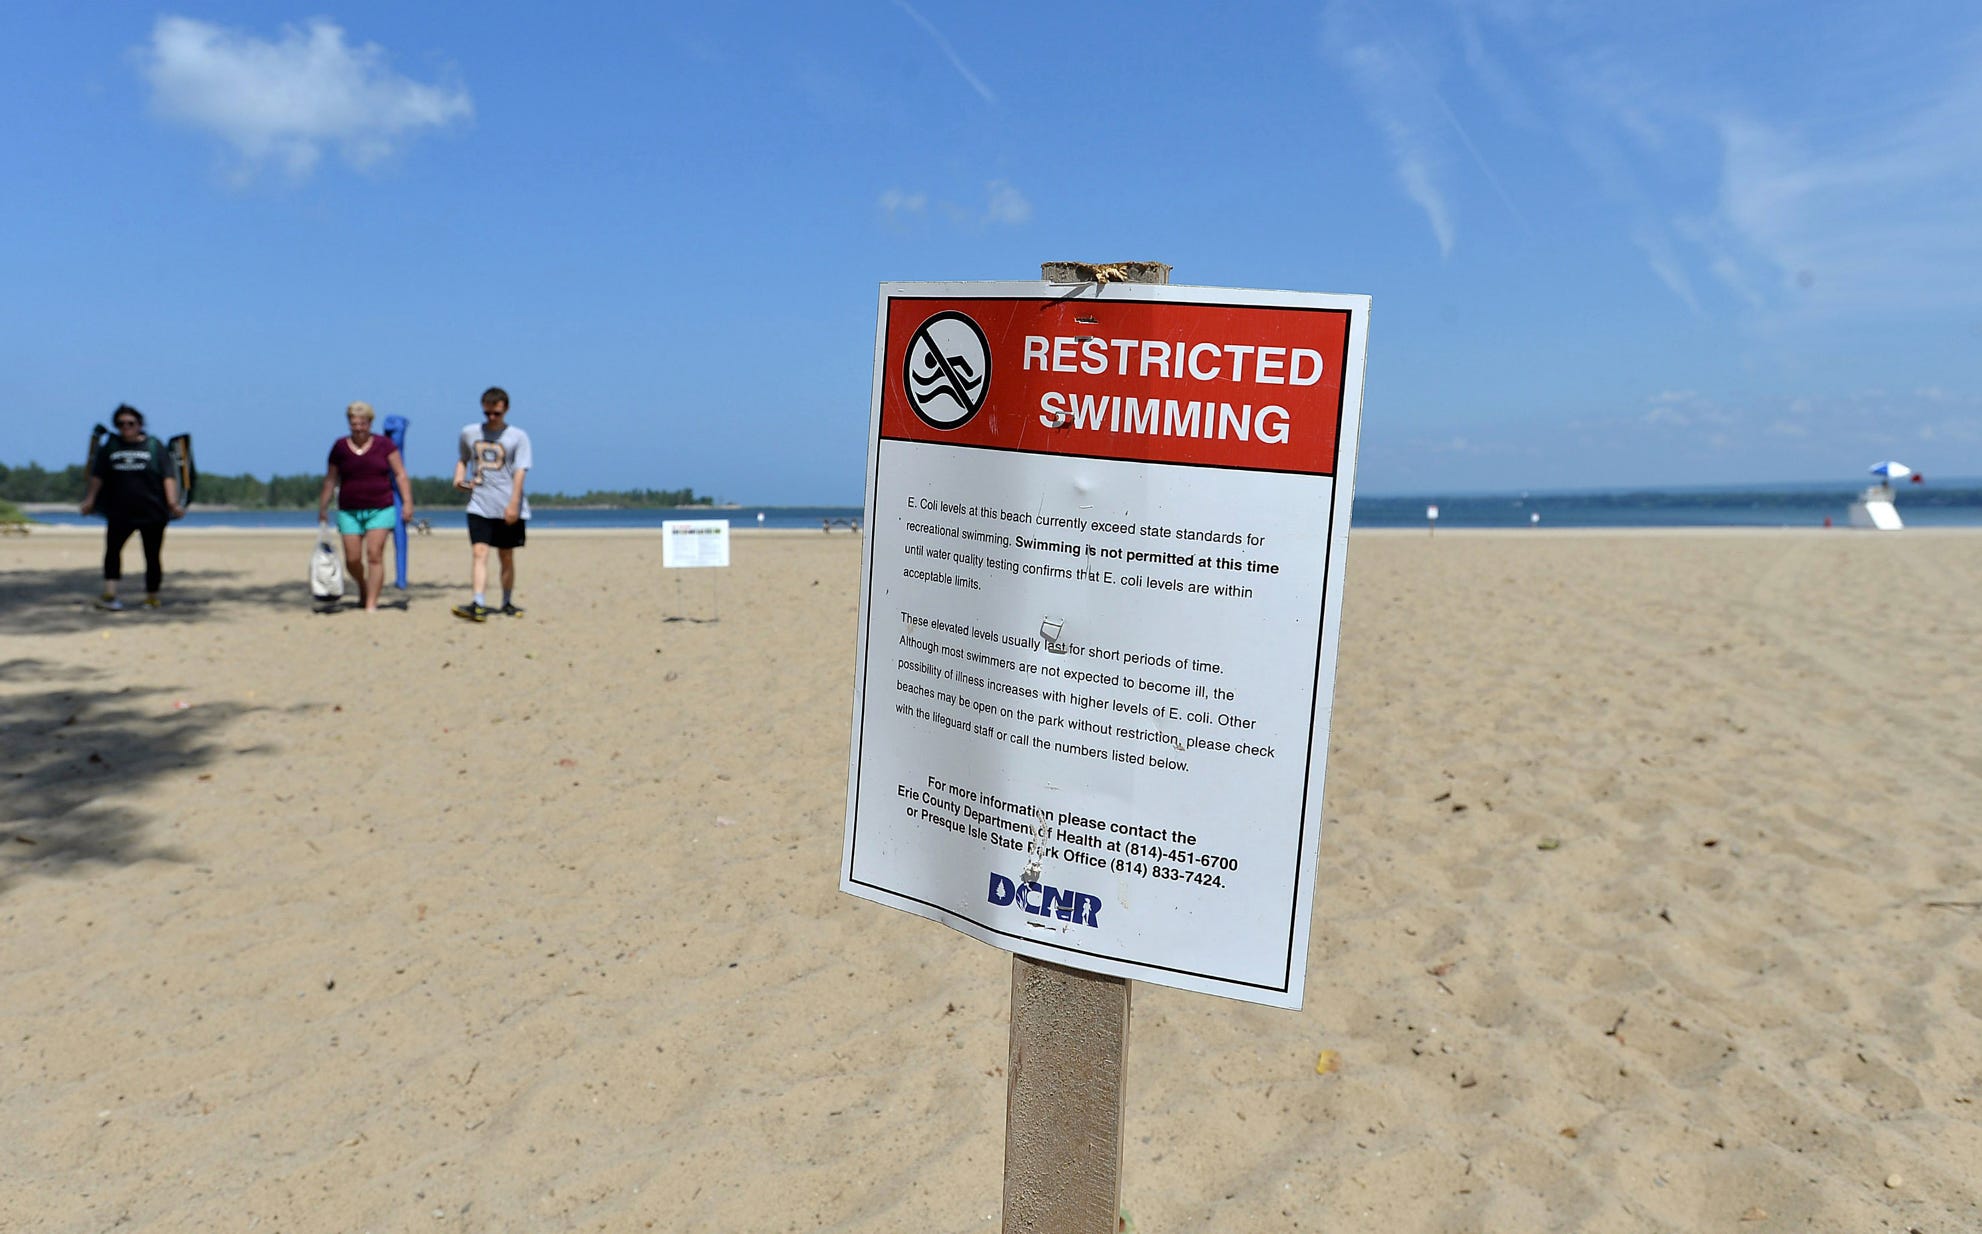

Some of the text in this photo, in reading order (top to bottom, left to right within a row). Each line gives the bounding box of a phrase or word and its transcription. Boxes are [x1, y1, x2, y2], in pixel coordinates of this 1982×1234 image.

[1023, 335, 1324, 387] RESTRICTED
[1039, 391, 1291, 444] SWIMMING
[472, 440, 506, 486] P
[906, 522, 1279, 574] recreational swimming. Swimming is not permitted at this time
[908, 497, 1265, 546] E. Coli levels at this beach currently exceed state standards for
[903, 568, 981, 590] acceptable limits.
[905, 545, 1253, 598] until water quality testing confirms that E. coli levels are within
[899, 635, 1234, 701] Although most swimmers are not expected to become ill, the
[901, 611, 1223, 674] These elevated levels usually last for short periods of time.
[897, 679, 1275, 758] beaches may be open on the park without restriction, please check
[898, 659, 1256, 729] possibility of illness increases with higher levels of E. coli. Other
[896, 703, 1189, 772] with the lifeguard staff or call the numbers listed below.
[898, 784, 1238, 871] Erie County Department of Health at (814)-451-6700
[928, 776, 1196, 845] For more information please contact the
[906, 807, 918, 818] or
[921, 809, 965, 833] Presque
[968, 824, 987, 841] Isle
[990, 832, 1023, 851] State
[1063, 849, 1107, 868] Office
[1110, 857, 1147, 878] (814)
[1152, 865, 1225, 888] 833-7424.
[987, 871, 1103, 928] DCNR
